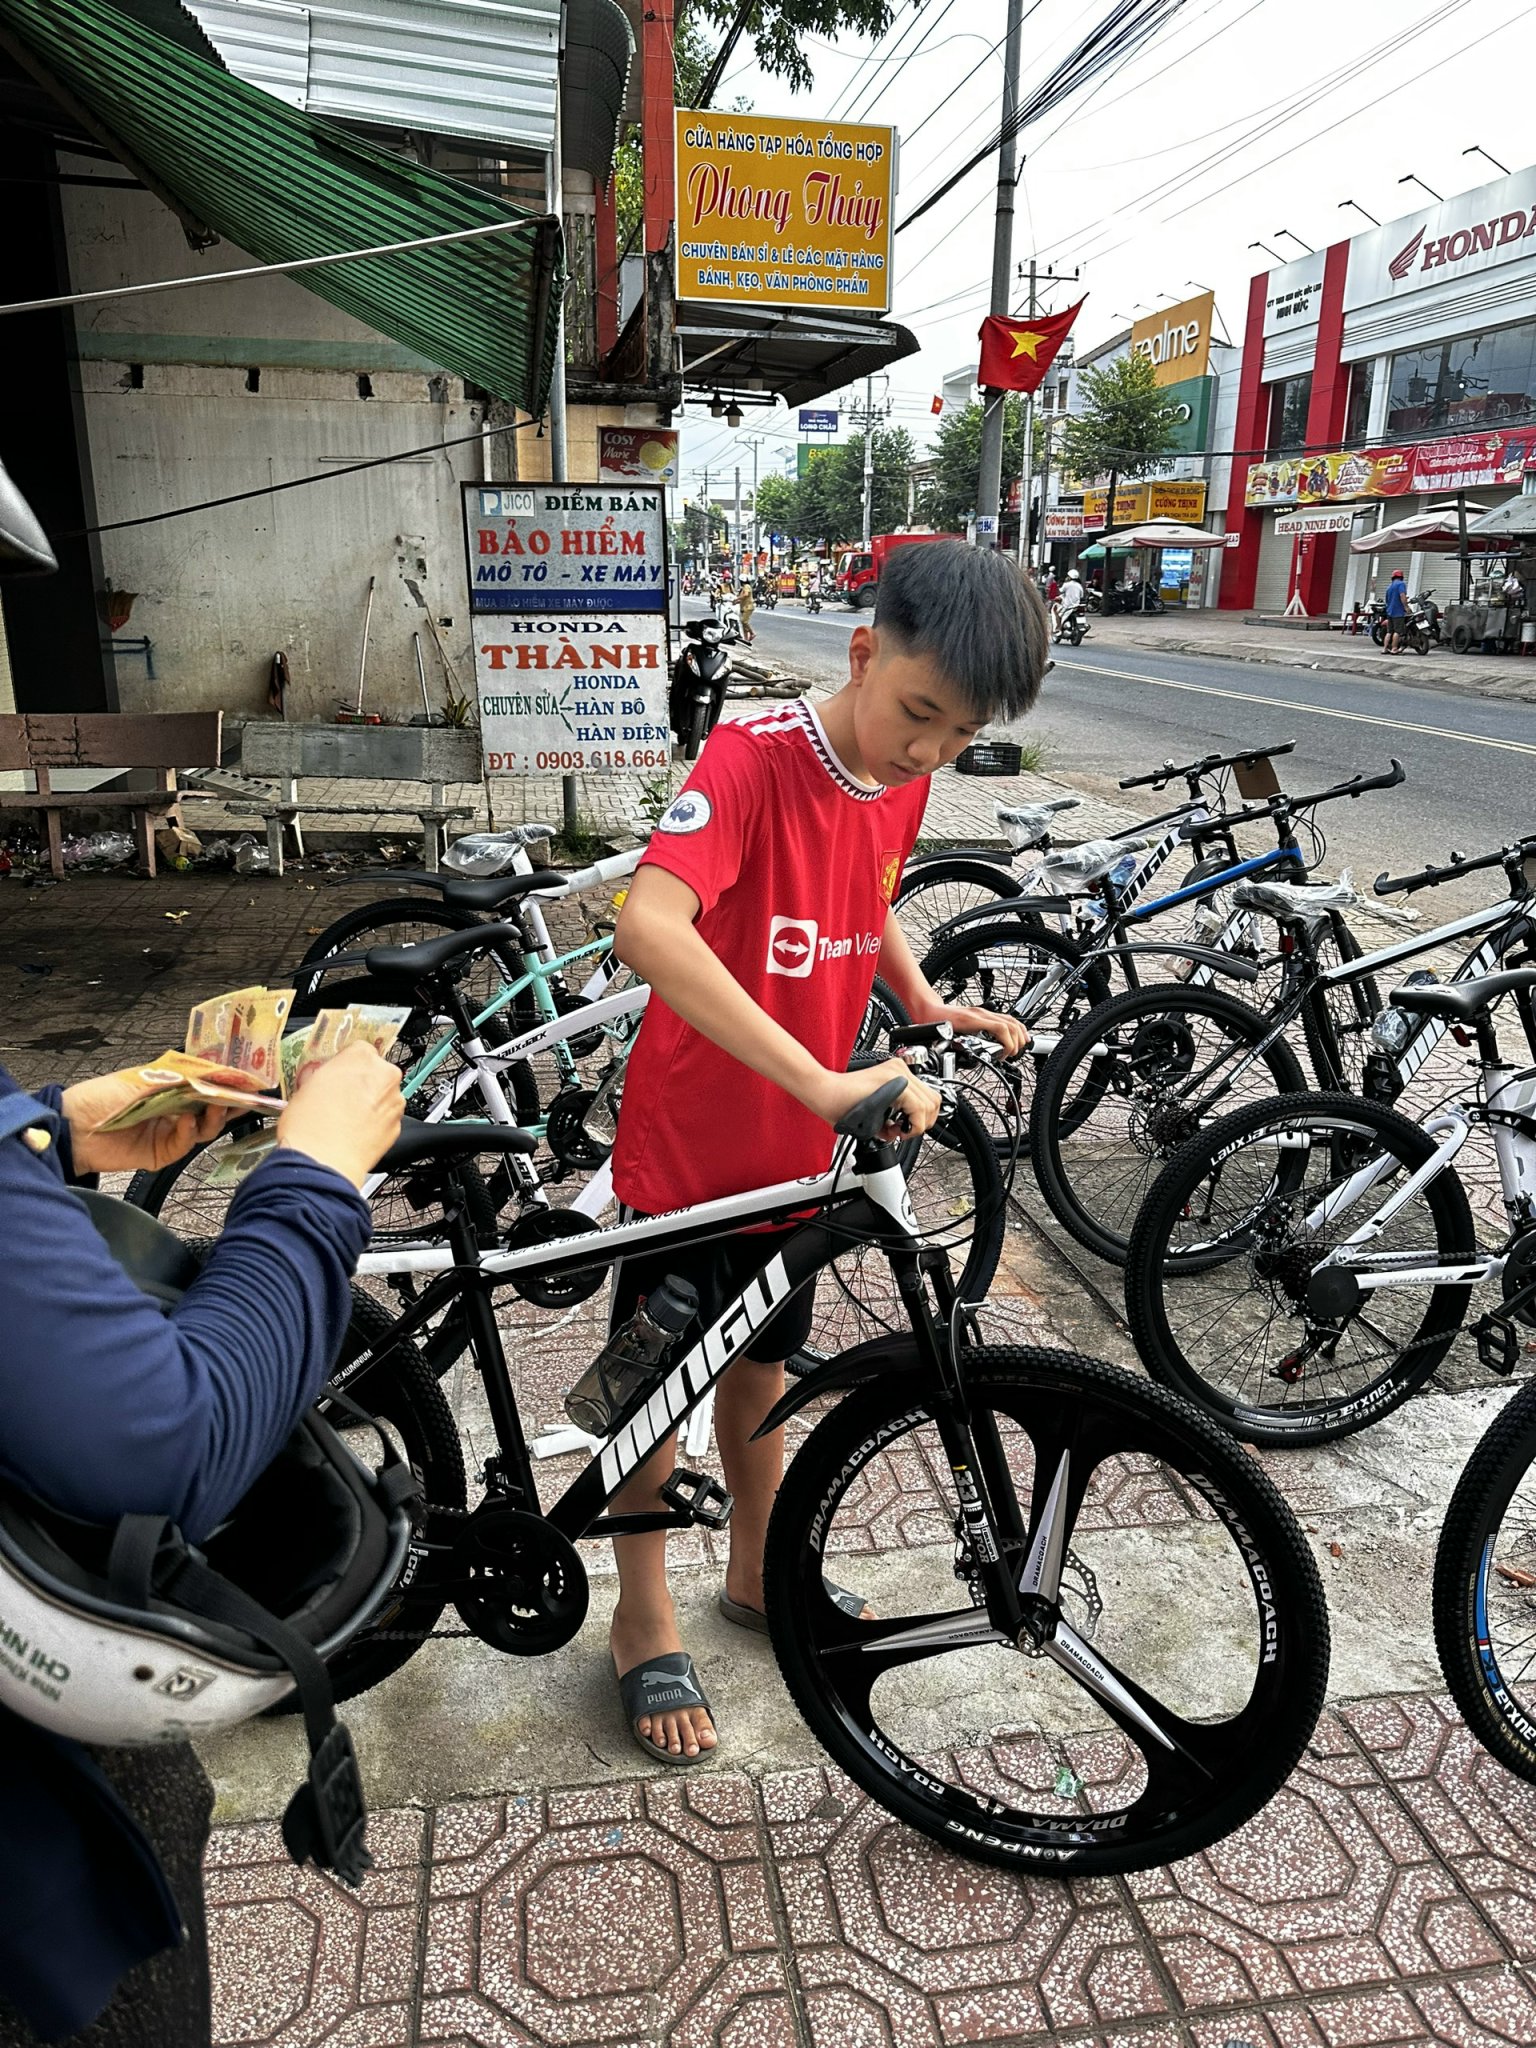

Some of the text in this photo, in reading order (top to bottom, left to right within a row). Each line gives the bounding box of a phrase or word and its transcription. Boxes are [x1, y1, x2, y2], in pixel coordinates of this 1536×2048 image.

[685, 124, 883, 167] CỬA HÀNG TẠP HÓA TỔNG HỢP
[688, 162, 884, 239] Phong Thủy
[682, 242, 884, 270] CHUYÊN BÁN SỈ & LẺ CÁC MẶT HÀNG
[698, 266, 869, 294] BÁNH, KẸO, VĂN PHÒNG PHẨM
[1135, 320, 1199, 365] ealme
[604, 432, 636, 445] COSY
[544, 488, 658, 512] ĐIỂM BÁN
[477, 516, 646, 555] BẢO HIỂM
[1067, 516, 1082, 527] THỊN
[1278, 516, 1350, 532] HEAD NINH ĐỨC
[476, 561, 512, 582] MÔ
[522, 561, 548, 582] TÔ
[580, 565, 608, 582] XE
[614, 560, 661, 582] MÁY
[475, 598, 496, 608] MUA
[586, 598, 613, 610] ĐƯỢC
[510, 622, 628, 633] HONDA
[480, 637, 660, 670] THÀNH
[573, 675, 640, 690] HONDA
[483, 688, 646, 716] CHUYÊN SỬA HÀN BÔ
[577, 724, 668, 745] HÀN ĐIỆN
[488, 752, 516, 771] ĐT
[536, 750, 668, 771] 0903.618.664
[818, 936, 853, 961] Team
[342, 1348, 374, 1379] ALUMINIUM
[808, 1408, 930, 1553] DRAMACOACH
[954, 1470, 978, 1500] 33
[1031, 1535, 1049, 1587] DRAMACOACH
[1188, 1472, 1277, 1664] DRAMACOACH
[948, 1628, 995, 1640] RAMACOACH
[1060, 1639, 1104, 1681] DRAMACOACH
[647, 1688, 682, 1704] PUMA
[870, 1729, 945, 1795] COACH
[1032, 1814, 1128, 1832] DRAMA
